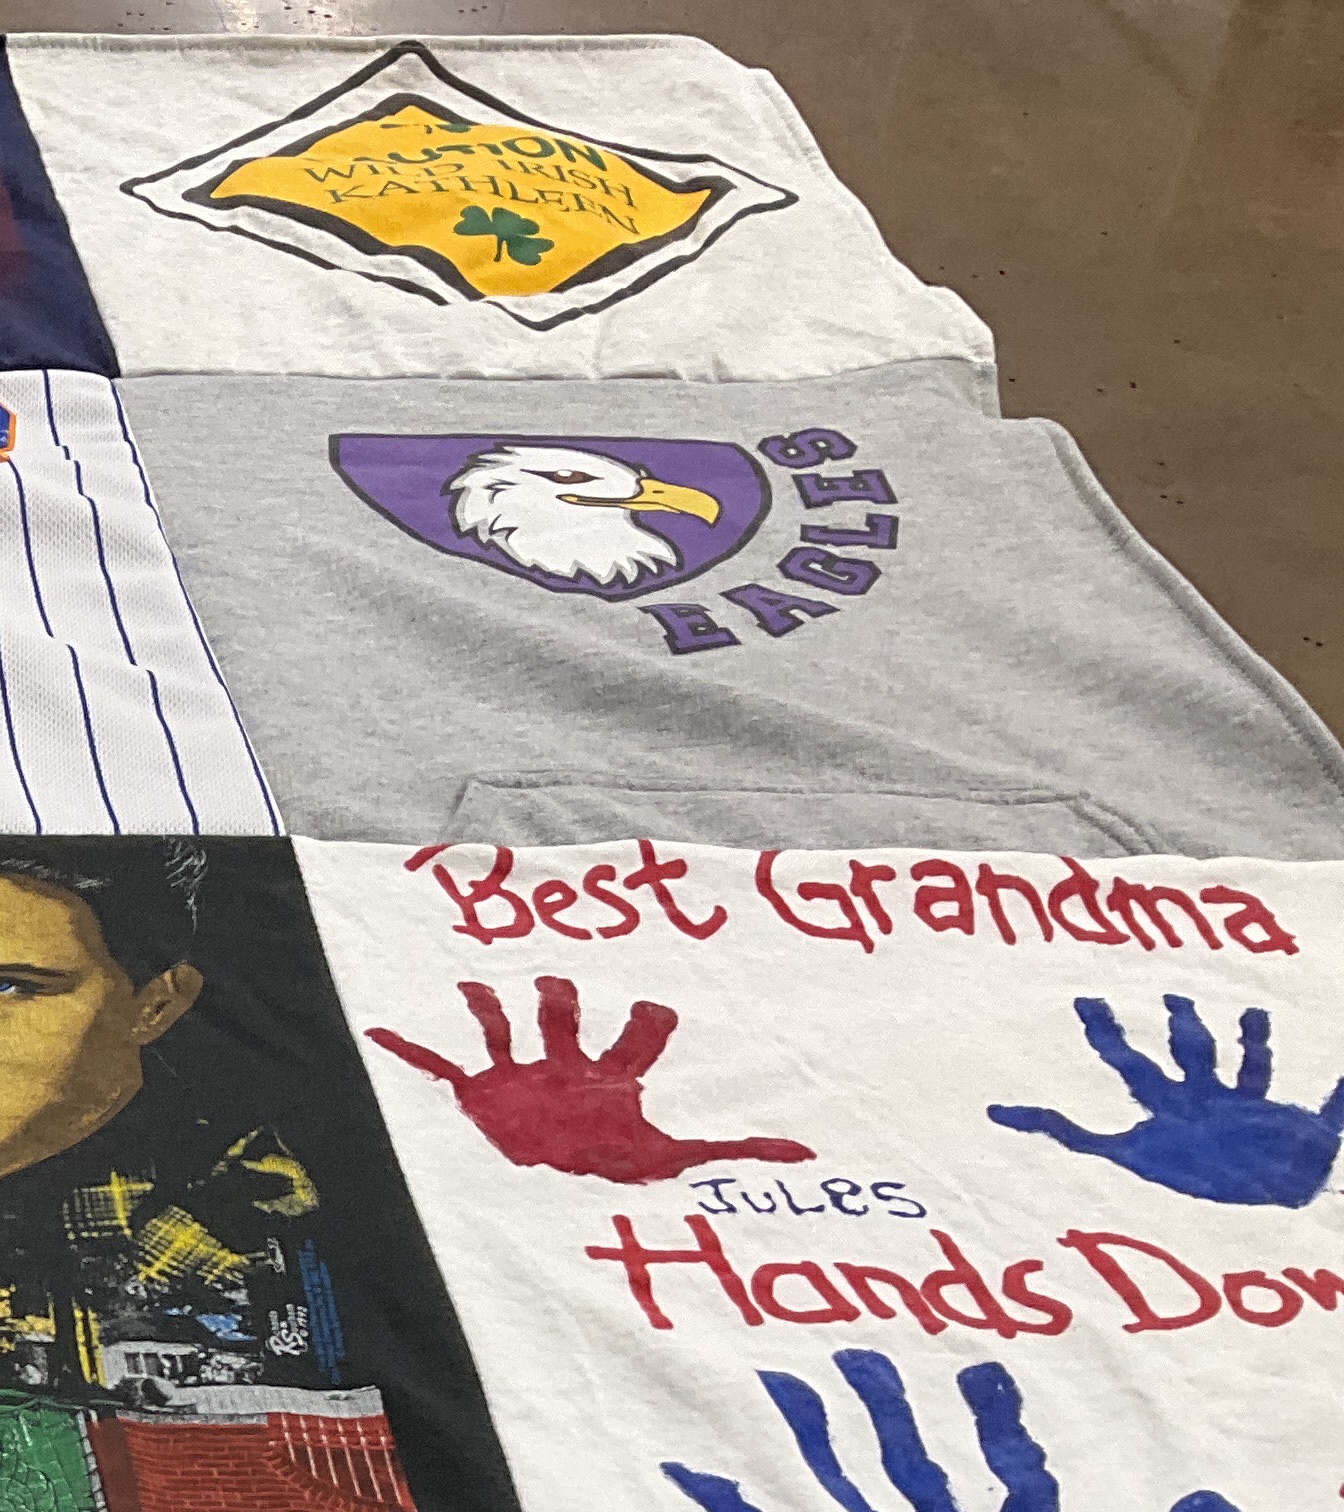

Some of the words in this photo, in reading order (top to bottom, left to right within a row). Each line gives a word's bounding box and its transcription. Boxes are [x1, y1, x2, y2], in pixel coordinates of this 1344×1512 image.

[303, 162, 465, 184] WILD
[495, 158, 638, 208] IRISH
[324, 175, 640, 235] KATHLEEN
[635, 427, 899, 655] EAGLES
[405, 838, 728, 945] Best
[754, 849, 1301, 956] Grandma
[585, 1213, 1075, 1338] Hands
